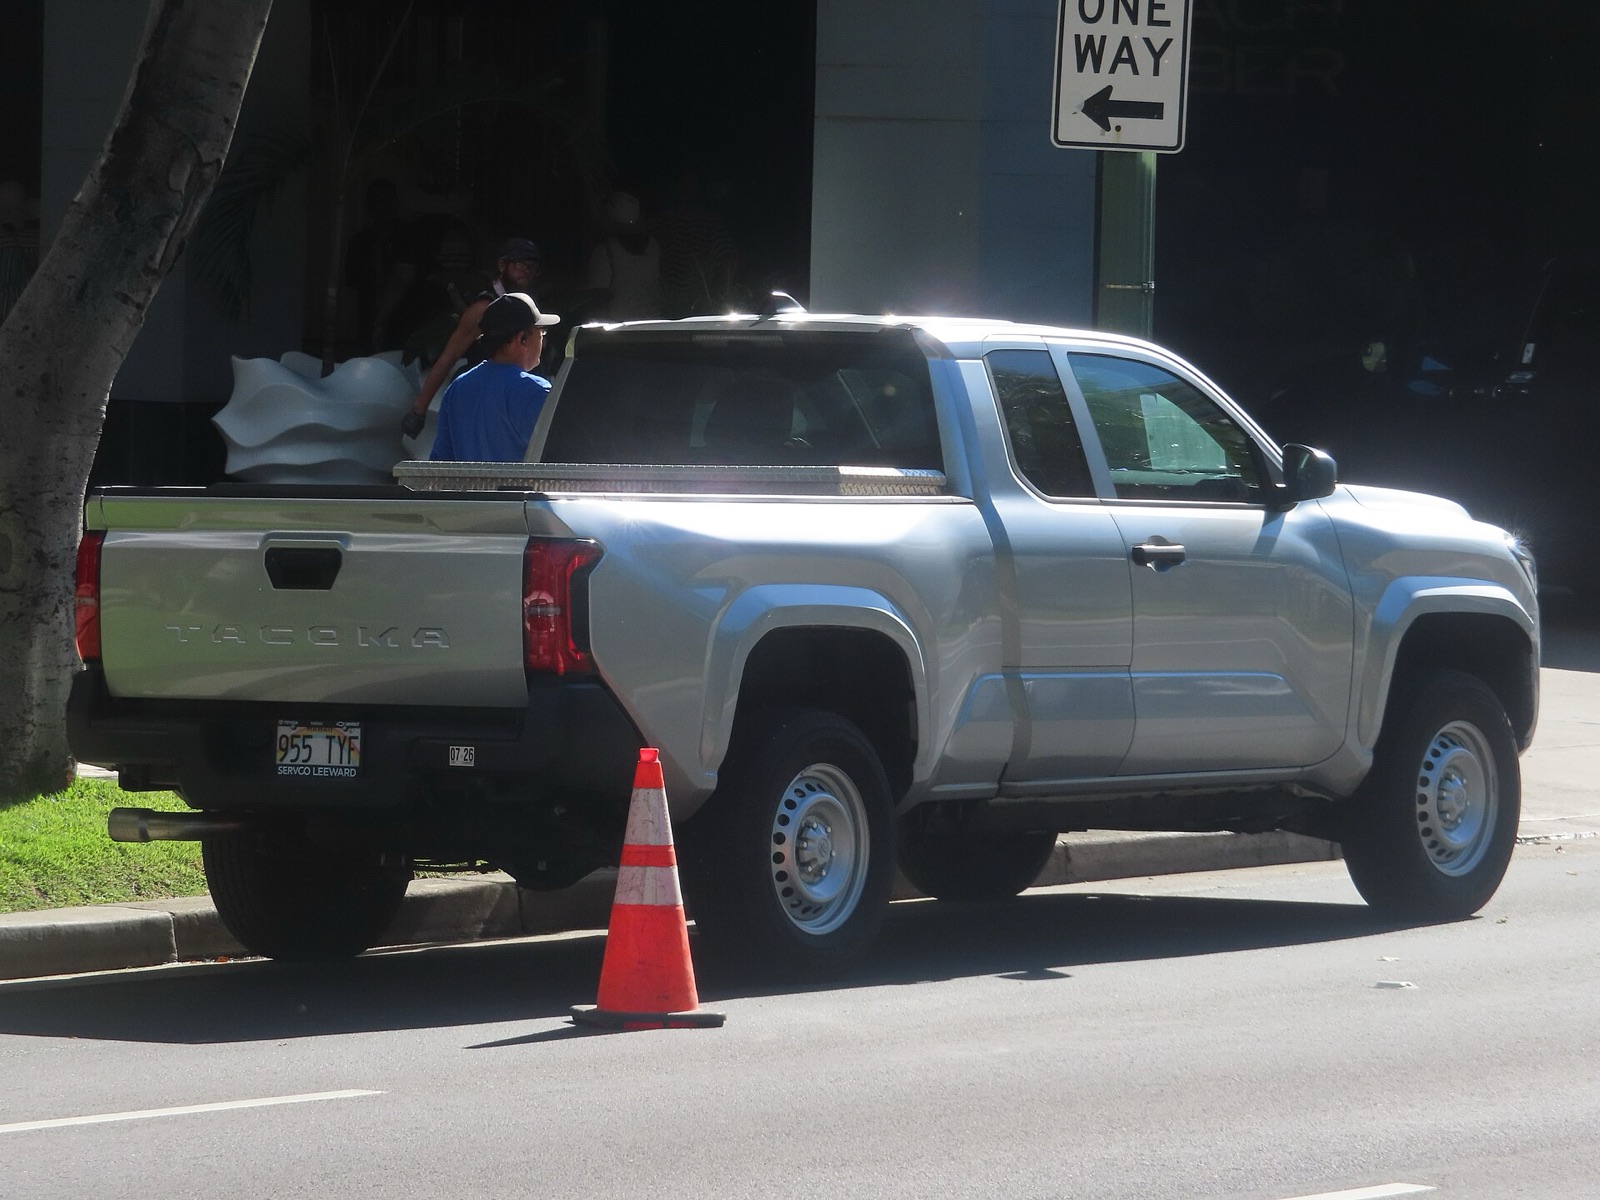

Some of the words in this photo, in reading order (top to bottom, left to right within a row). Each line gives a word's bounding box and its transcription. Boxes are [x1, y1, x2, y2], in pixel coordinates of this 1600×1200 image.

[1078, 0, 1171, 27] ONE
[1073, 33, 1174, 77] WAY
[165, 623, 450, 649] TACOMA
[278, 734, 313, 764] 955
[325, 735, 359, 765] TYF
[451, 747, 460, 761] 07
[463, 748, 474, 762] 26
[277, 766, 311, 776] SERVCO
[312, 767, 357, 778] LEEWARD
